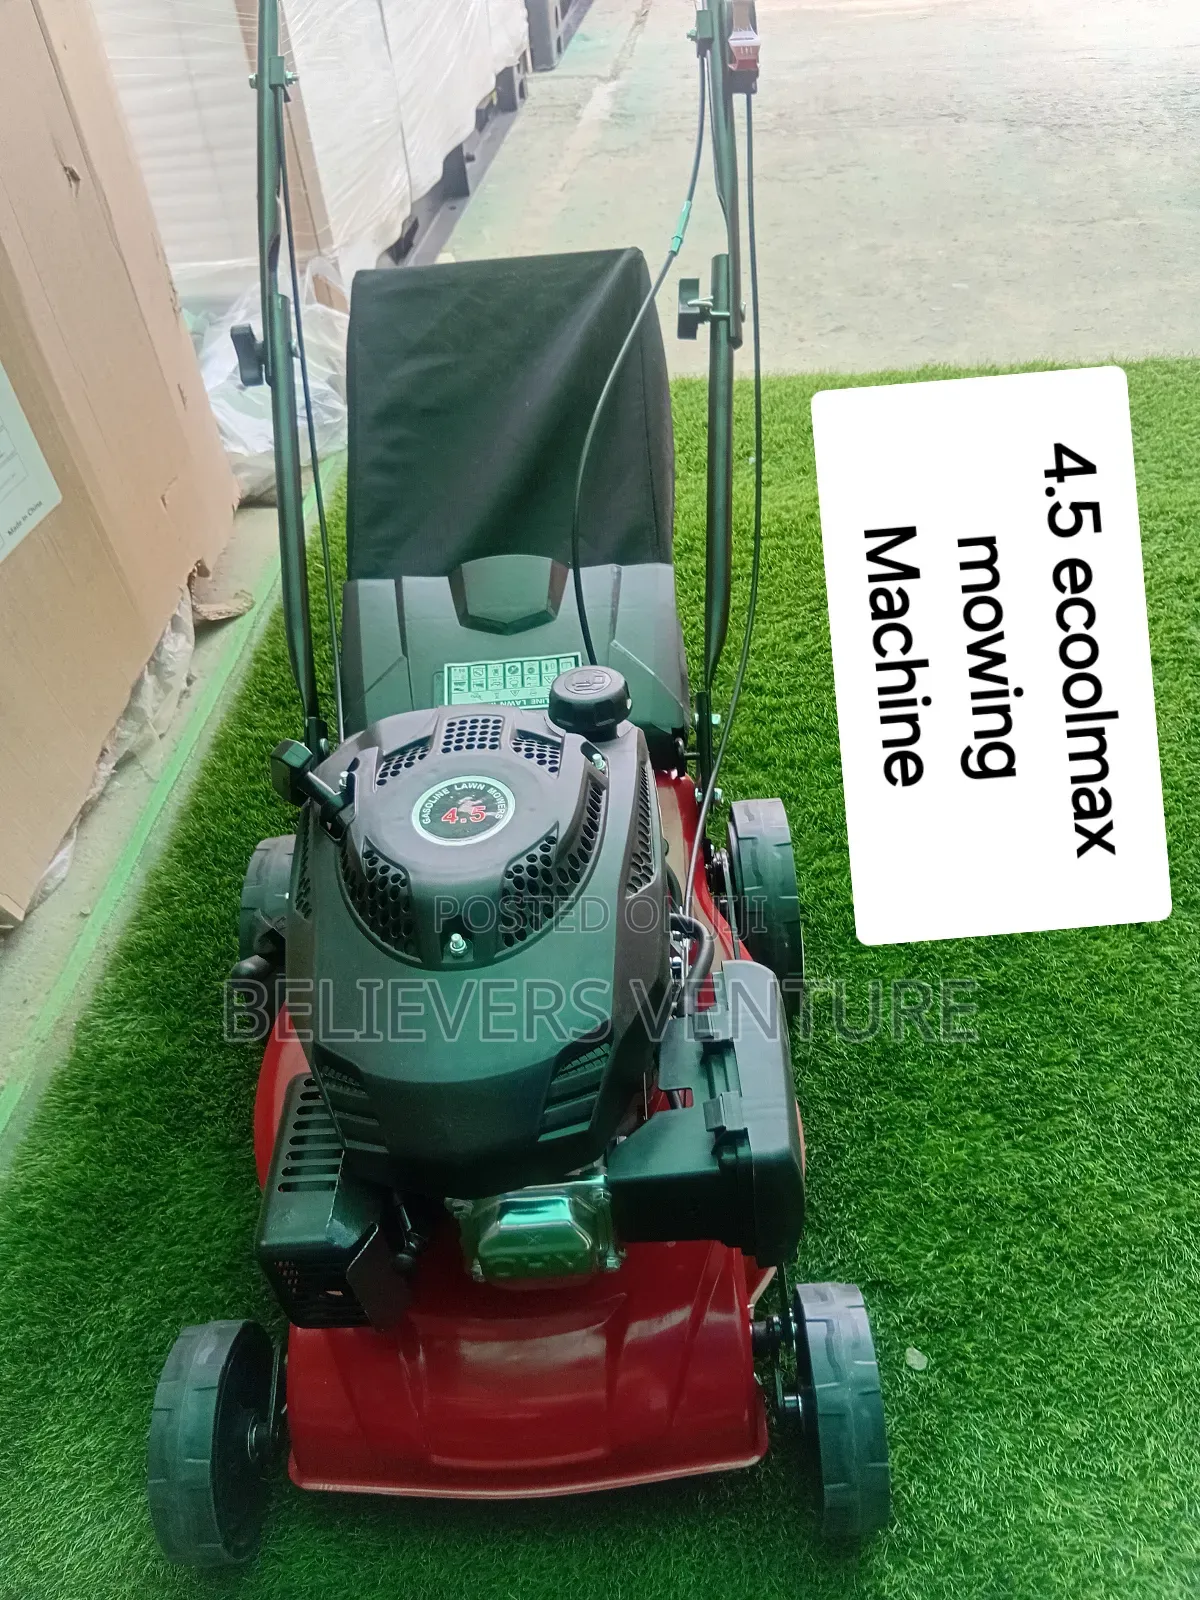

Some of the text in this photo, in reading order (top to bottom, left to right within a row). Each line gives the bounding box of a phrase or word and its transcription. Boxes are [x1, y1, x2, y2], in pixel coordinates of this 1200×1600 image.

[422, 782, 506, 824] GASOLINE LAWN MOWERS
[441, 805, 487, 824] 4.5
